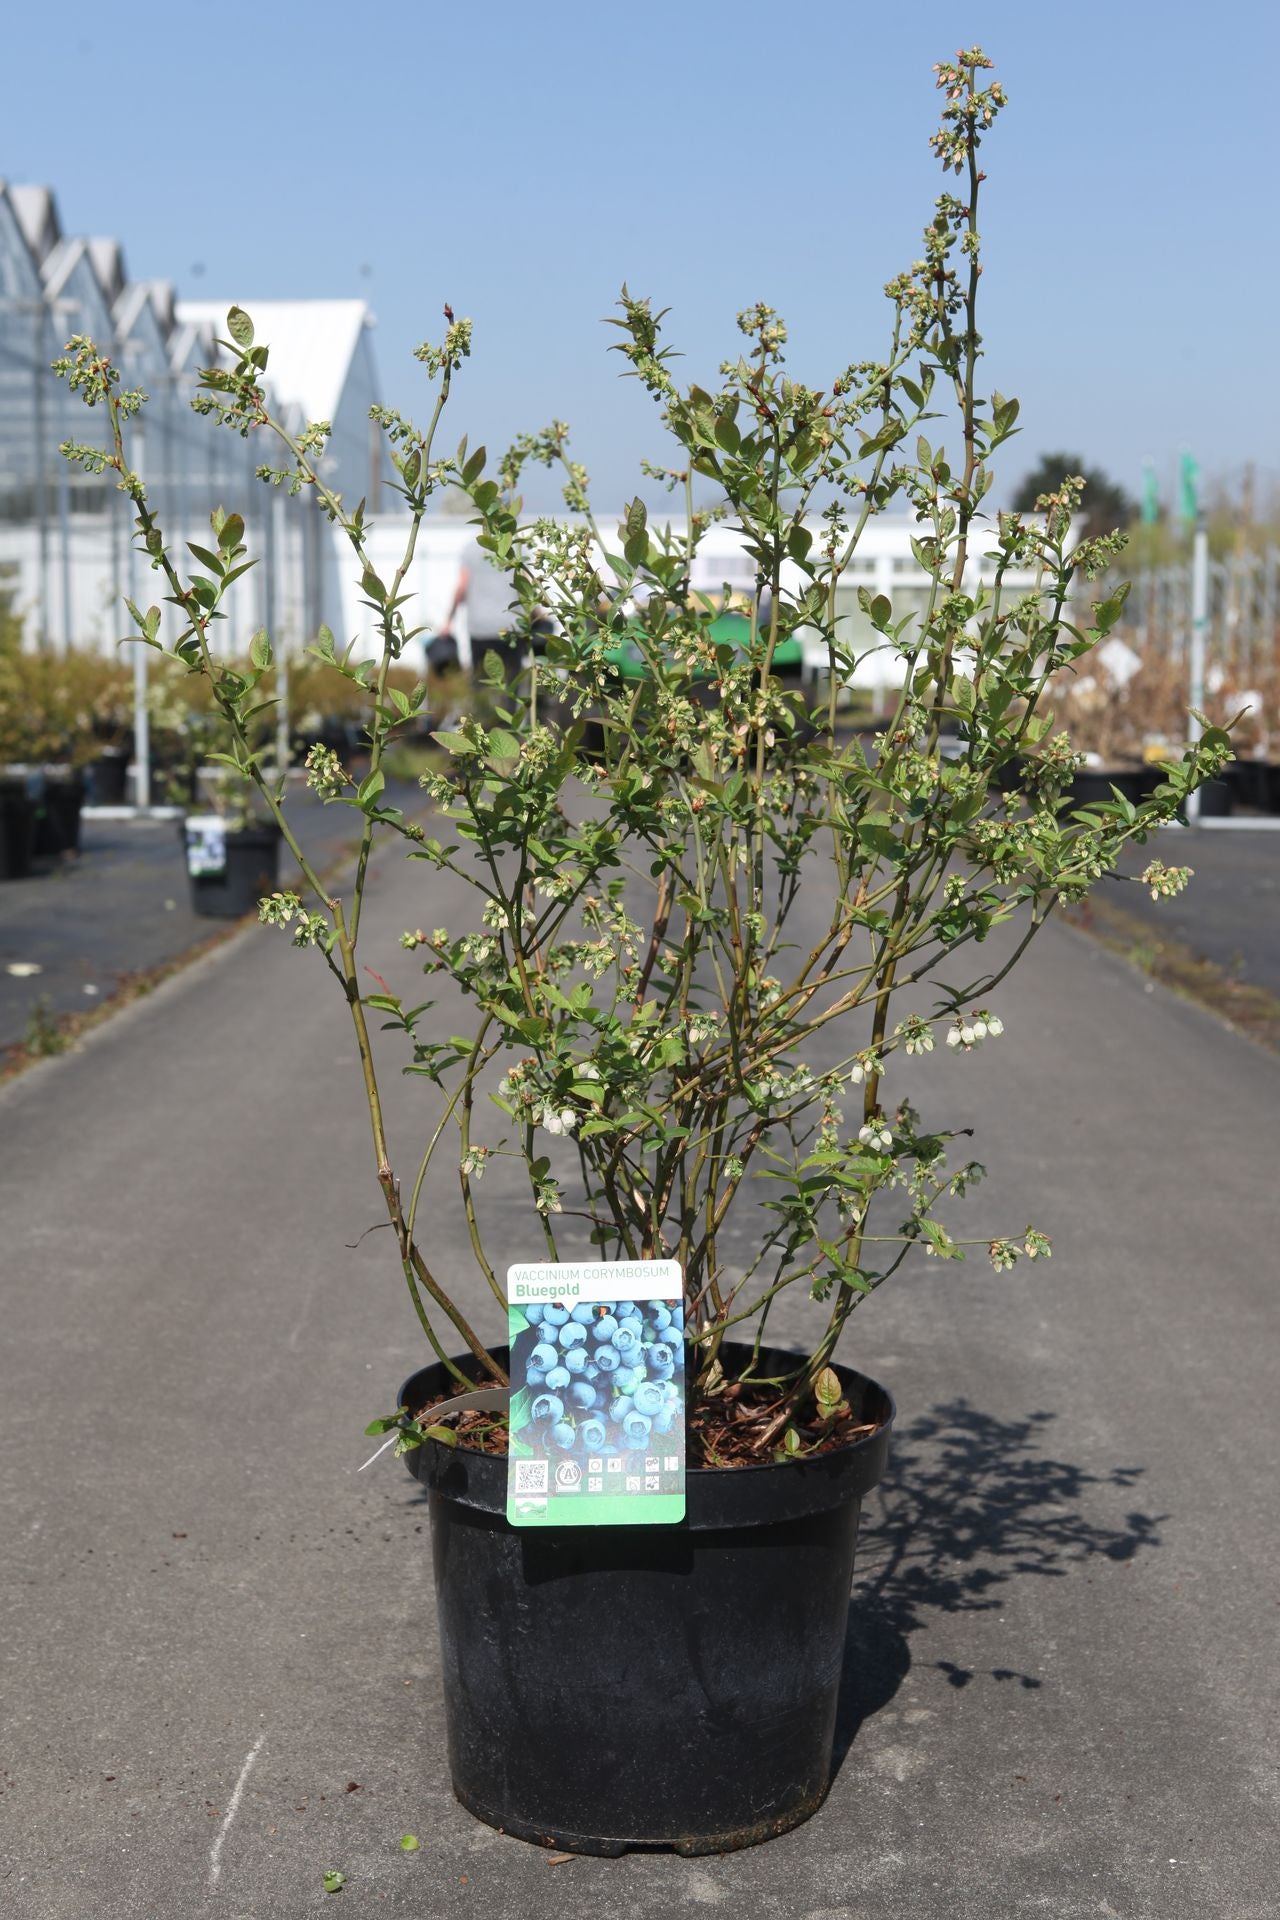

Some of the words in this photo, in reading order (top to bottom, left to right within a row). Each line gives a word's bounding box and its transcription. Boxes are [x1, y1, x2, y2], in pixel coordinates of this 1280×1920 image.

[515, 1269, 580, 1281] VACCINIUM
[583, 1267, 669, 1280] CORYMBOSUM
[516, 1283, 580, 1299] Bluegold
